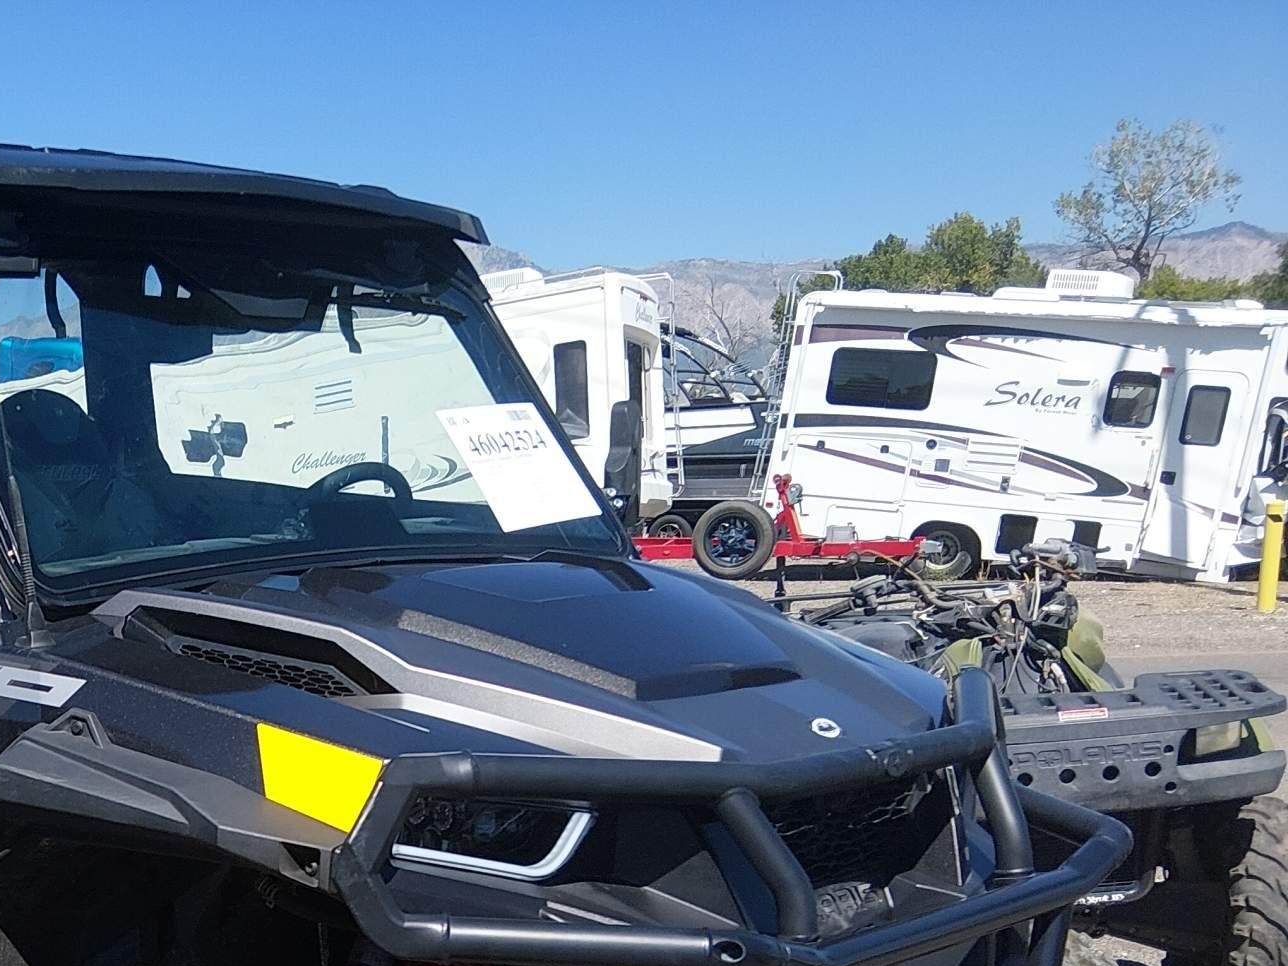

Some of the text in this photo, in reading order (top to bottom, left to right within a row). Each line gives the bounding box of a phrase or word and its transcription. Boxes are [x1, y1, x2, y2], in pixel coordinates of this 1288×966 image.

[984, 381, 1081, 409] Solera
[468, 429, 548, 456] 46042524
[291, 450, 367, 474] Challenger
[1011, 740, 1162, 771] POLARIS
